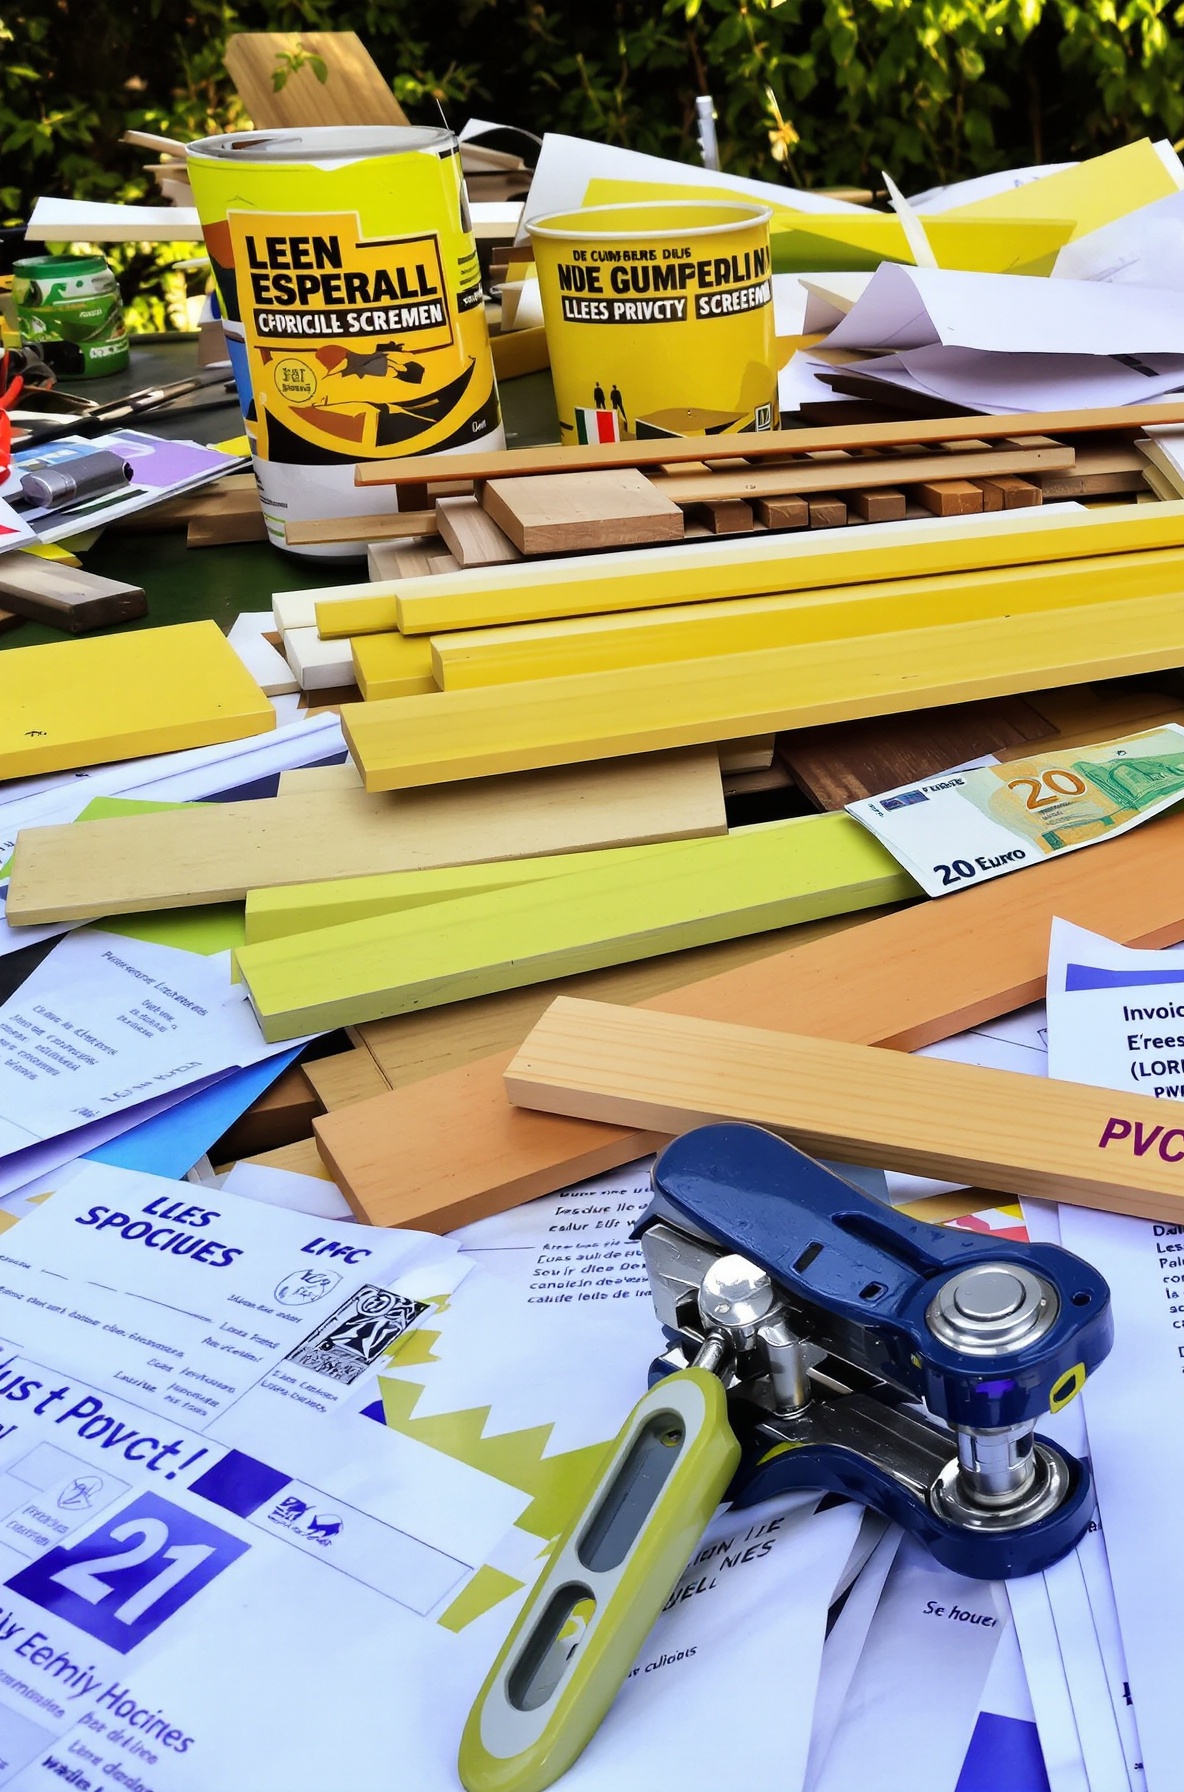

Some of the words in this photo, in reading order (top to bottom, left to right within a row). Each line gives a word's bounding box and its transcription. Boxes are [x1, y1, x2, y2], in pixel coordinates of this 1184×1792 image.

[245, 235, 343, 270] LEEN
[250, 264, 438, 306] ESPERALL
[348, 303, 443, 333] SCREMEN
[564, 299, 609, 320] LLEES
[614, 298, 686, 321] PRIVCTY
[1007, 769, 1086, 812] 20
[933, 858, 975, 886] 20
[141, 1195, 222, 1229] LLES
[75, 1205, 244, 1268] SPOCIUES
[49, 1517, 217, 1626] 21
